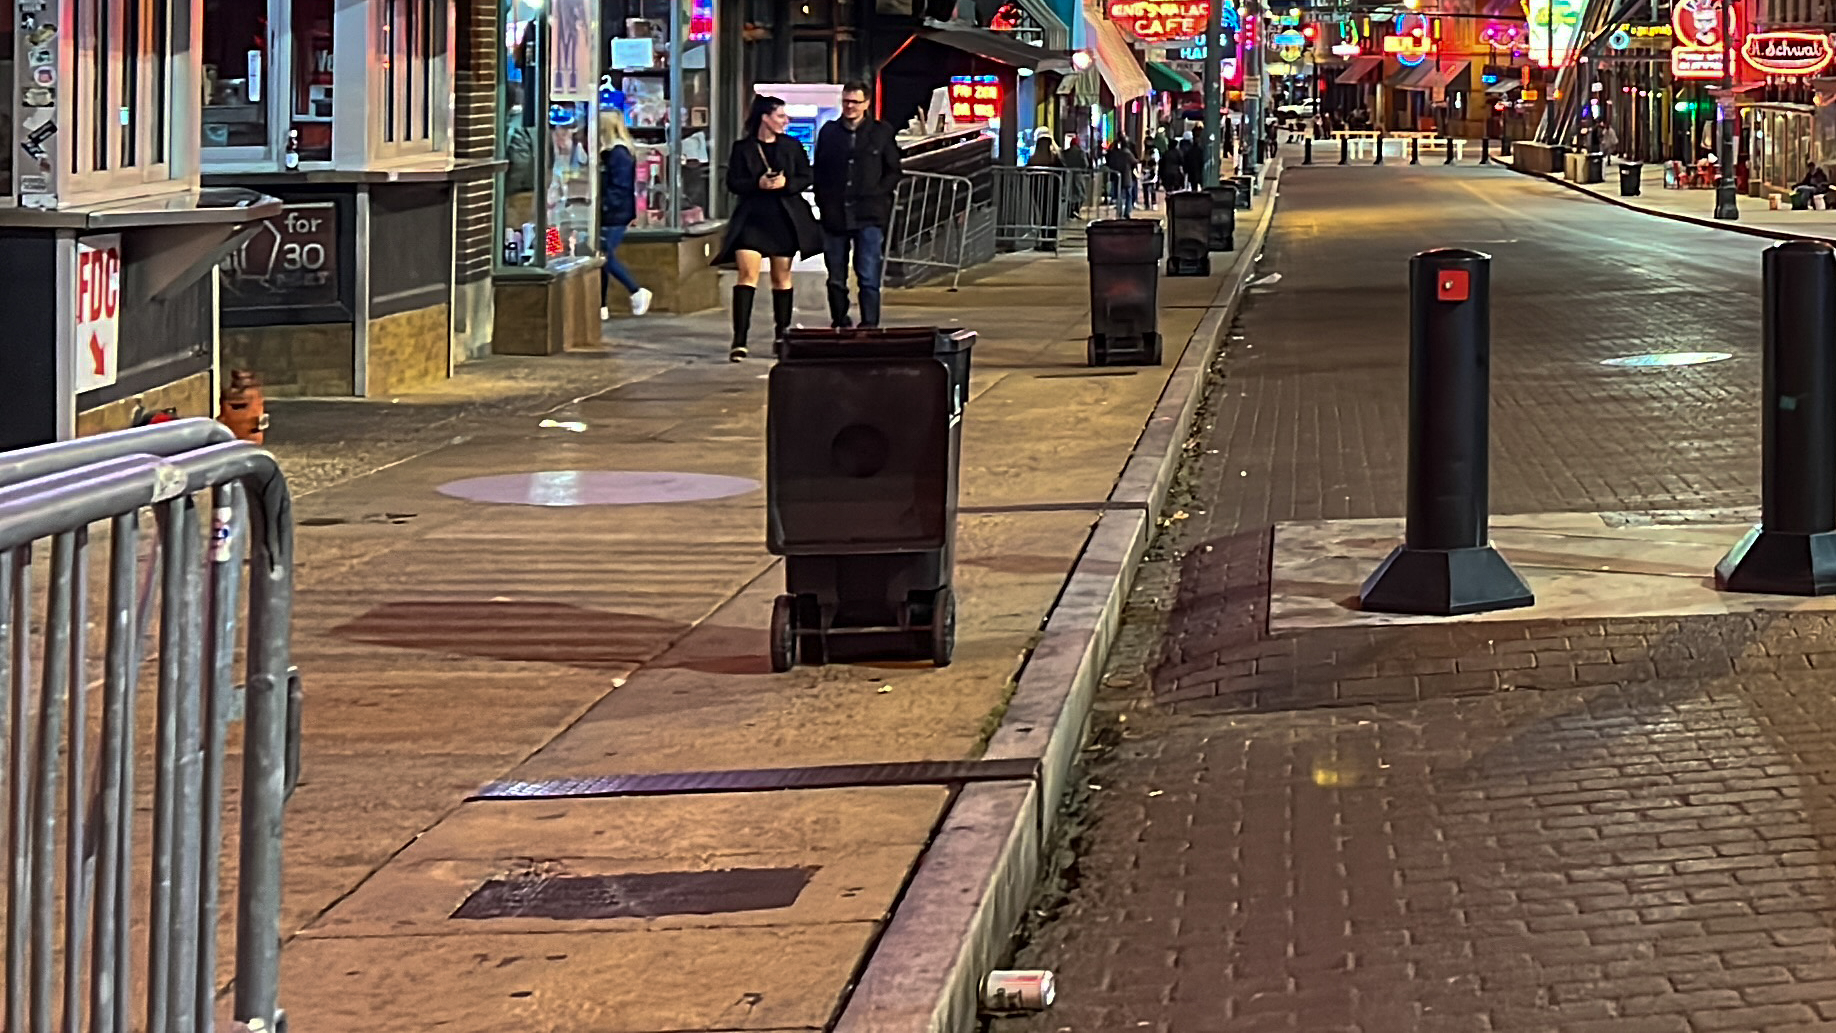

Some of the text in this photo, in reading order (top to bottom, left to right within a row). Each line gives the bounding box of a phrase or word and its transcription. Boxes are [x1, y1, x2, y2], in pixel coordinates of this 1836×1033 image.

[1134, 18, 1195, 34] CAFE
[284, 212, 322, 233] for
[283, 243, 325, 269] 30
[78, 247, 119, 326] FDC
